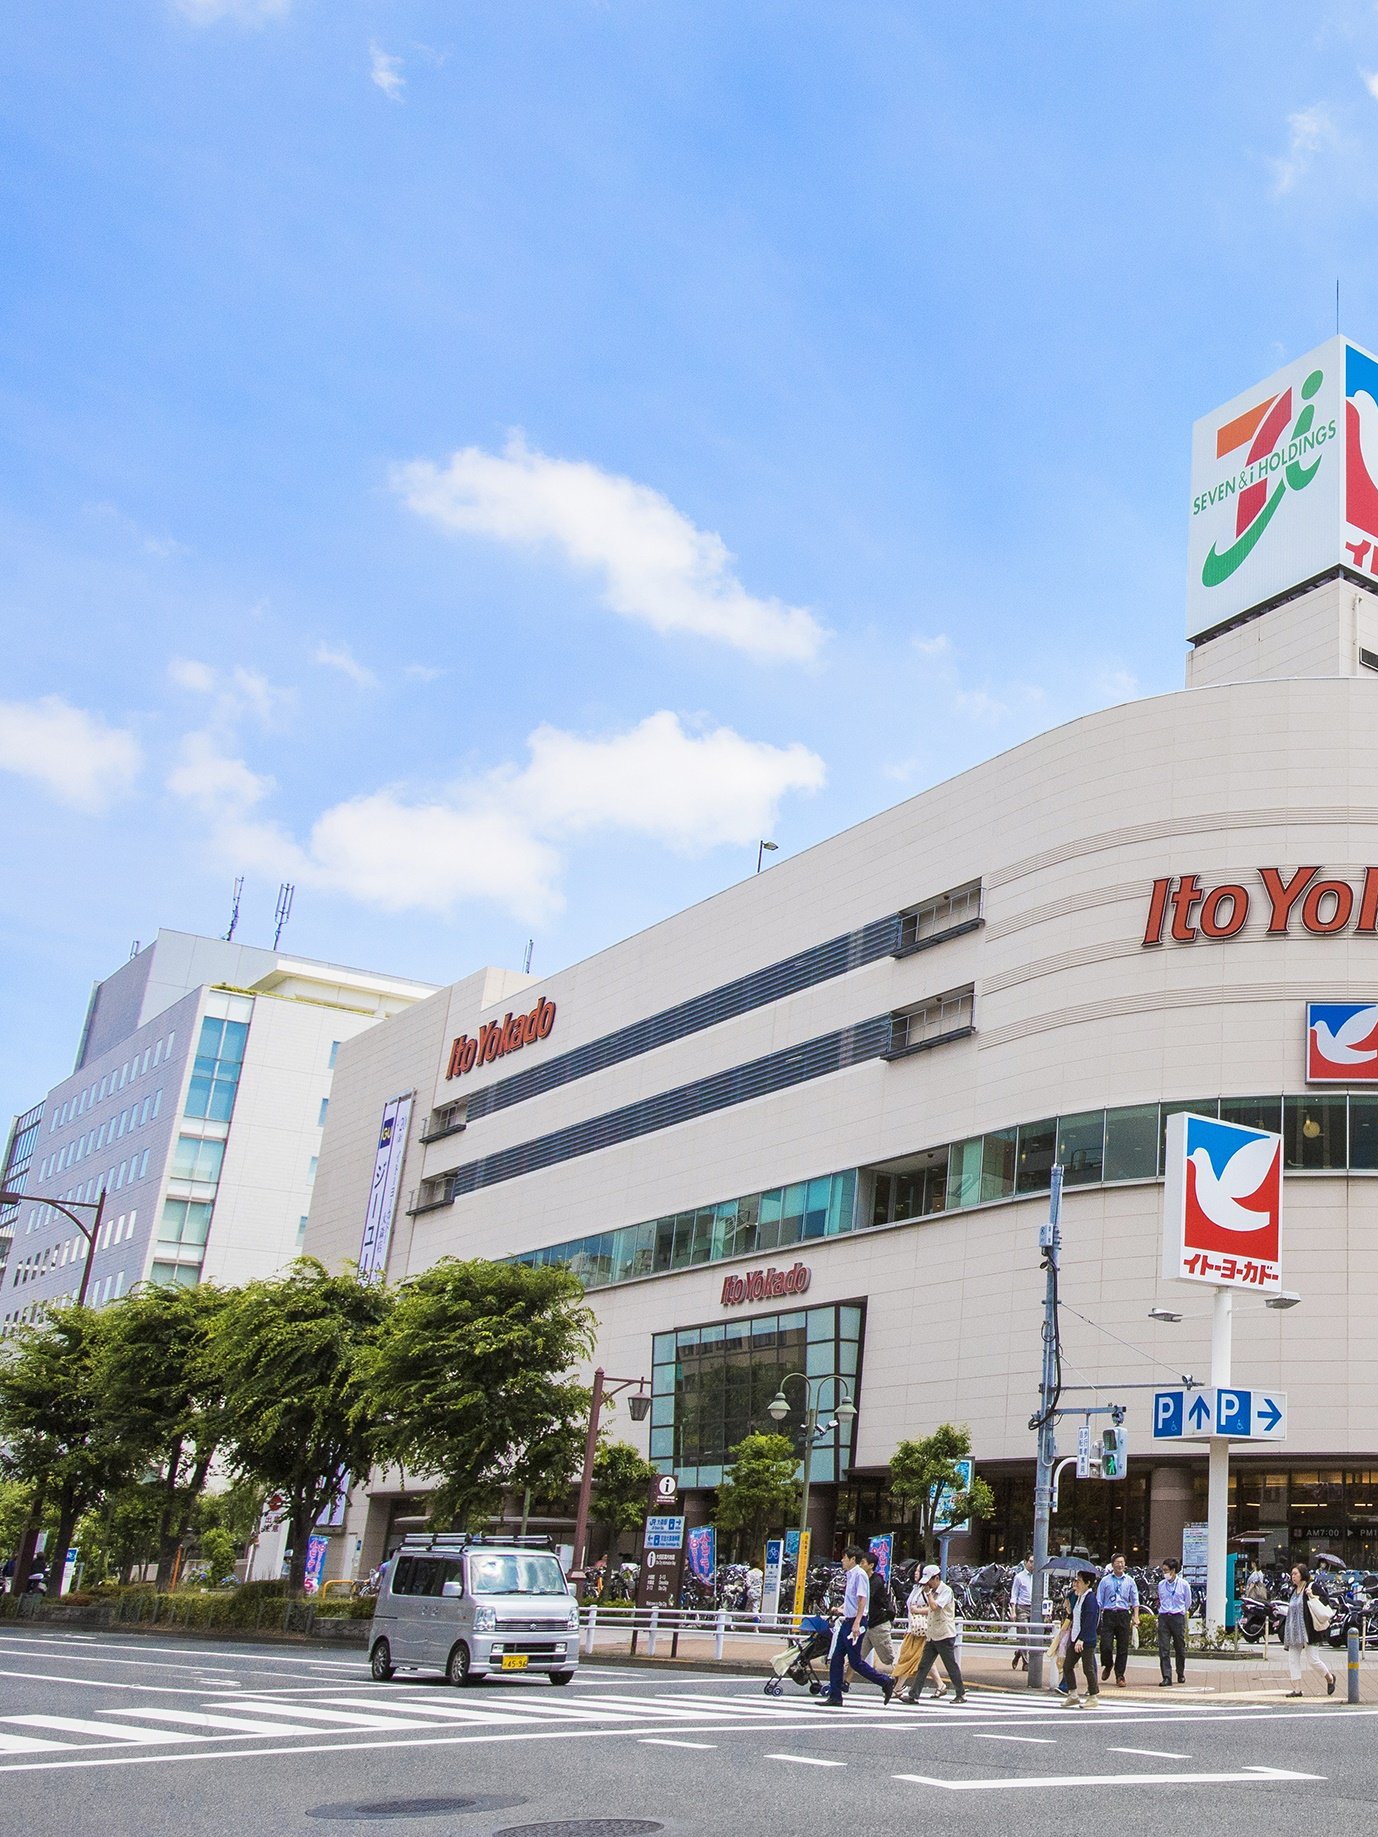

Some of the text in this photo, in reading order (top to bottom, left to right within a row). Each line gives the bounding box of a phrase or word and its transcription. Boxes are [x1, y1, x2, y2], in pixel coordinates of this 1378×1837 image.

[1192, 476, 1236, 516] SEVEN
[1258, 420, 1337, 479] HOLDINGS
[381, 1126, 392, 1141] GU
[1183, 1253, 1279, 1286] イトーヨーカドー
[1158, 1396, 1174, 1429] P
[1220, 1393, 1240, 1426] P
